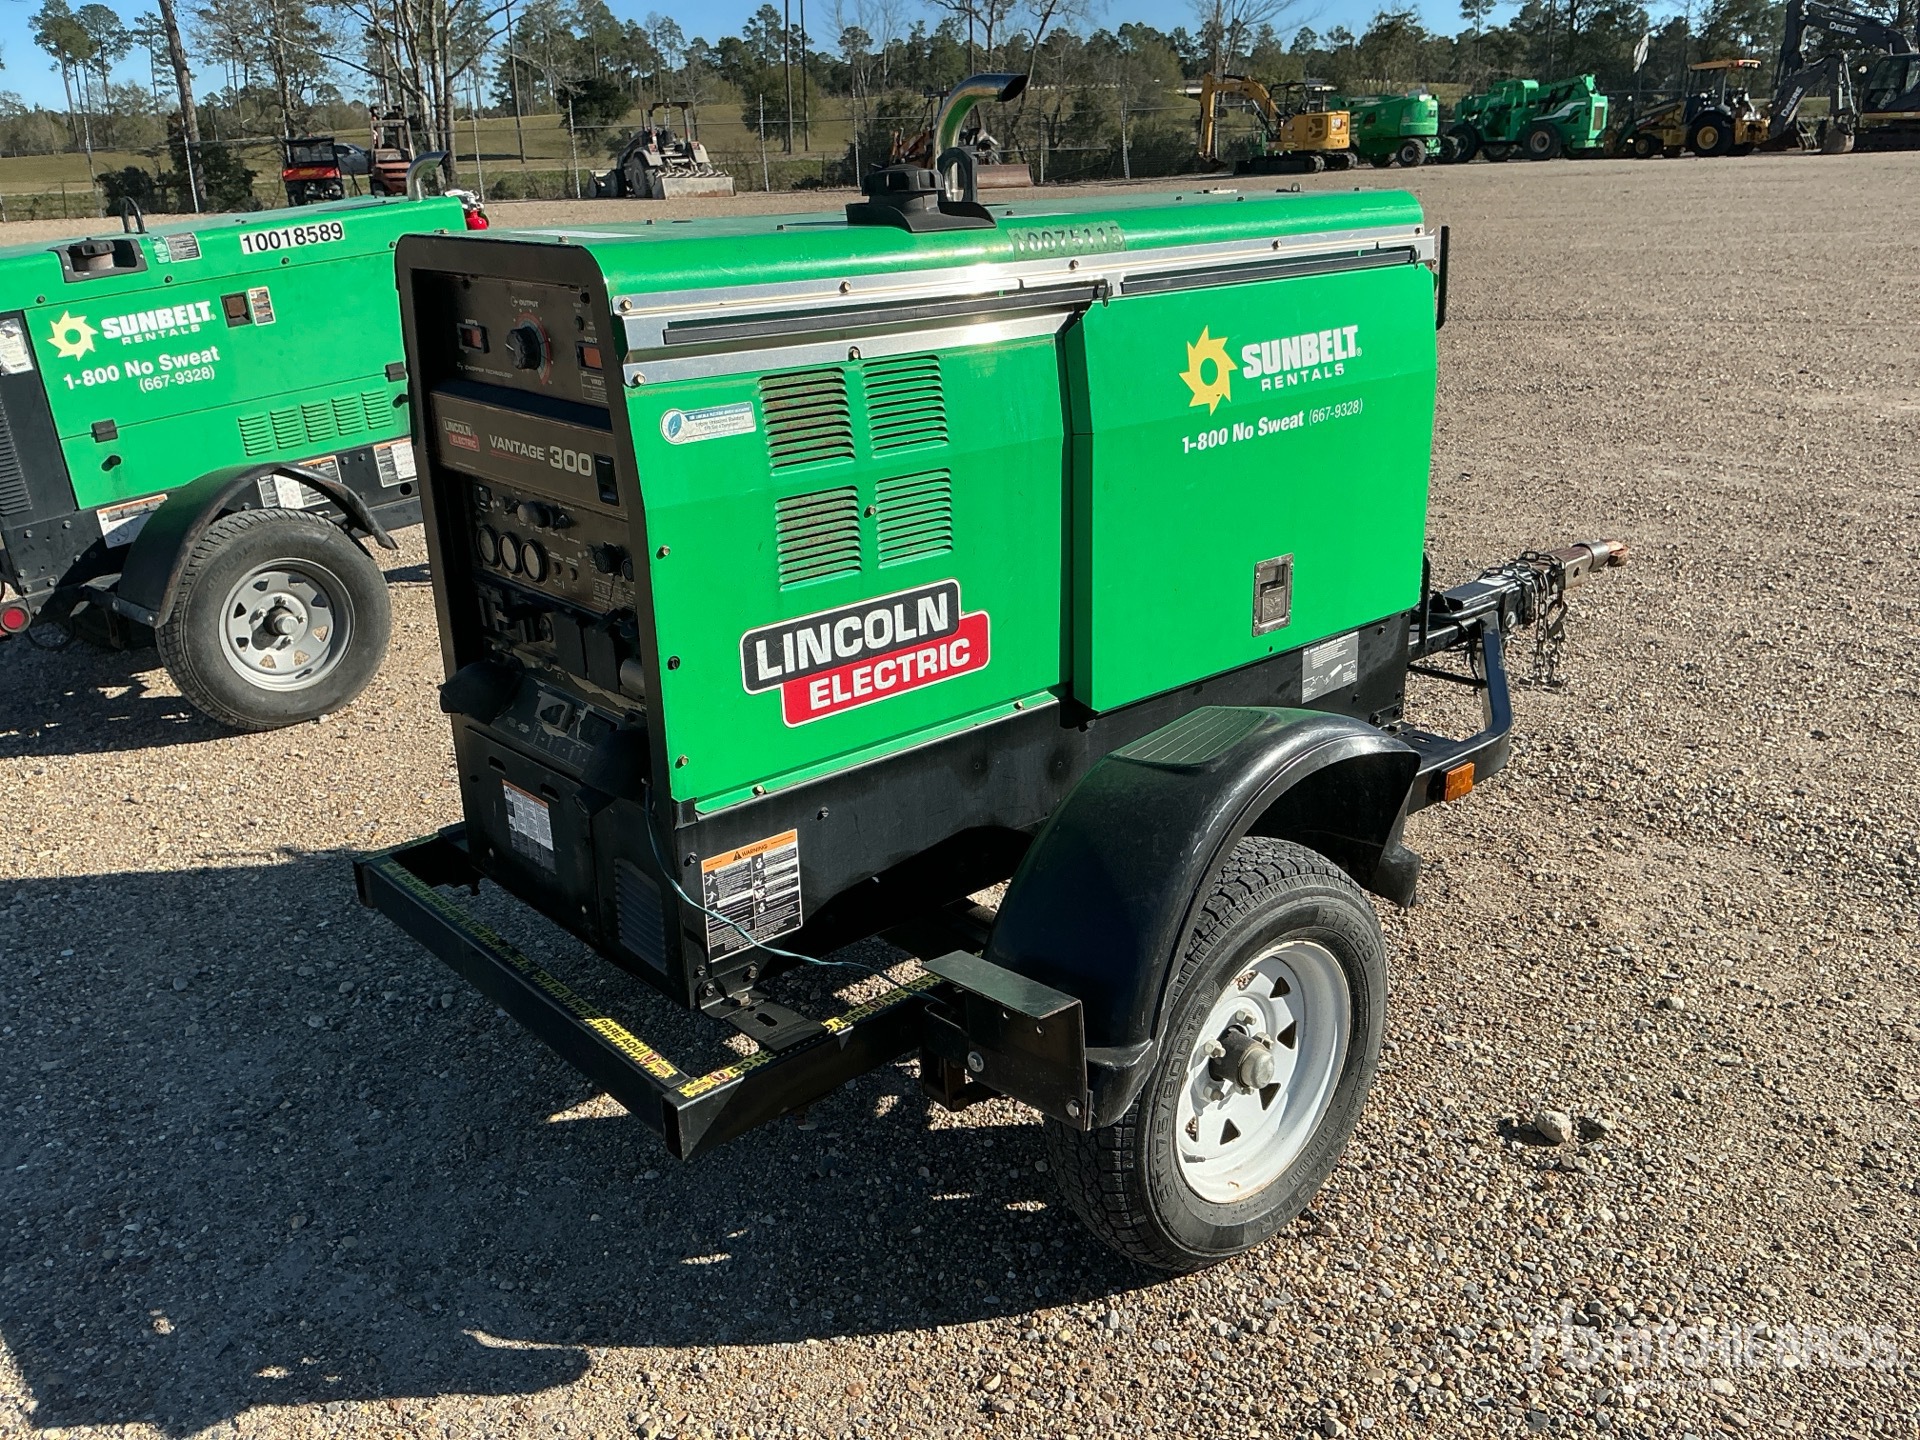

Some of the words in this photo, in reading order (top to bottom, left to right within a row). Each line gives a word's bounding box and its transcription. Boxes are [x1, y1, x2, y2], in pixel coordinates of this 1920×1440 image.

[1829, 22, 1858, 35] DEERE
[242, 222, 344, 254] 10018589
[1014, 225, 1124, 251] 10075115
[519, 300, 539, 308] OUTPUT
[122, 324, 200, 346] RENTALS
[64, 365, 120, 390] 1-800
[126, 356, 154, 379] No
[158, 346, 221, 372] Sweat
[139, 365, 216, 394] (667-9328)
[1261, 363, 1345, 391] RENTALS
[444, 420, 471, 437] LINCOLN
[1182, 428, 1228, 454] 1-800
[1232, 422, 1254, 443] No
[1258, 410, 1304, 436] Sweat
[1308, 398, 1364, 426] (667-9328)
[452, 436, 478, 449] ELECTRIC
[489, 434, 546, 461] VANTAGE
[549, 445, 592, 477] 300
[756, 592, 949, 681] LINCOLN
[809, 638, 970, 711] ELECTRIC
[741, 843, 768, 857] WARNING
[885, 991, 904, 1003] NE
[833, 1007, 870, 1026] HERE
[597, 1019, 624, 1039] PARE
[622, 1037, 646, 1056] AQUI
[730, 1060, 753, 1074] DO
